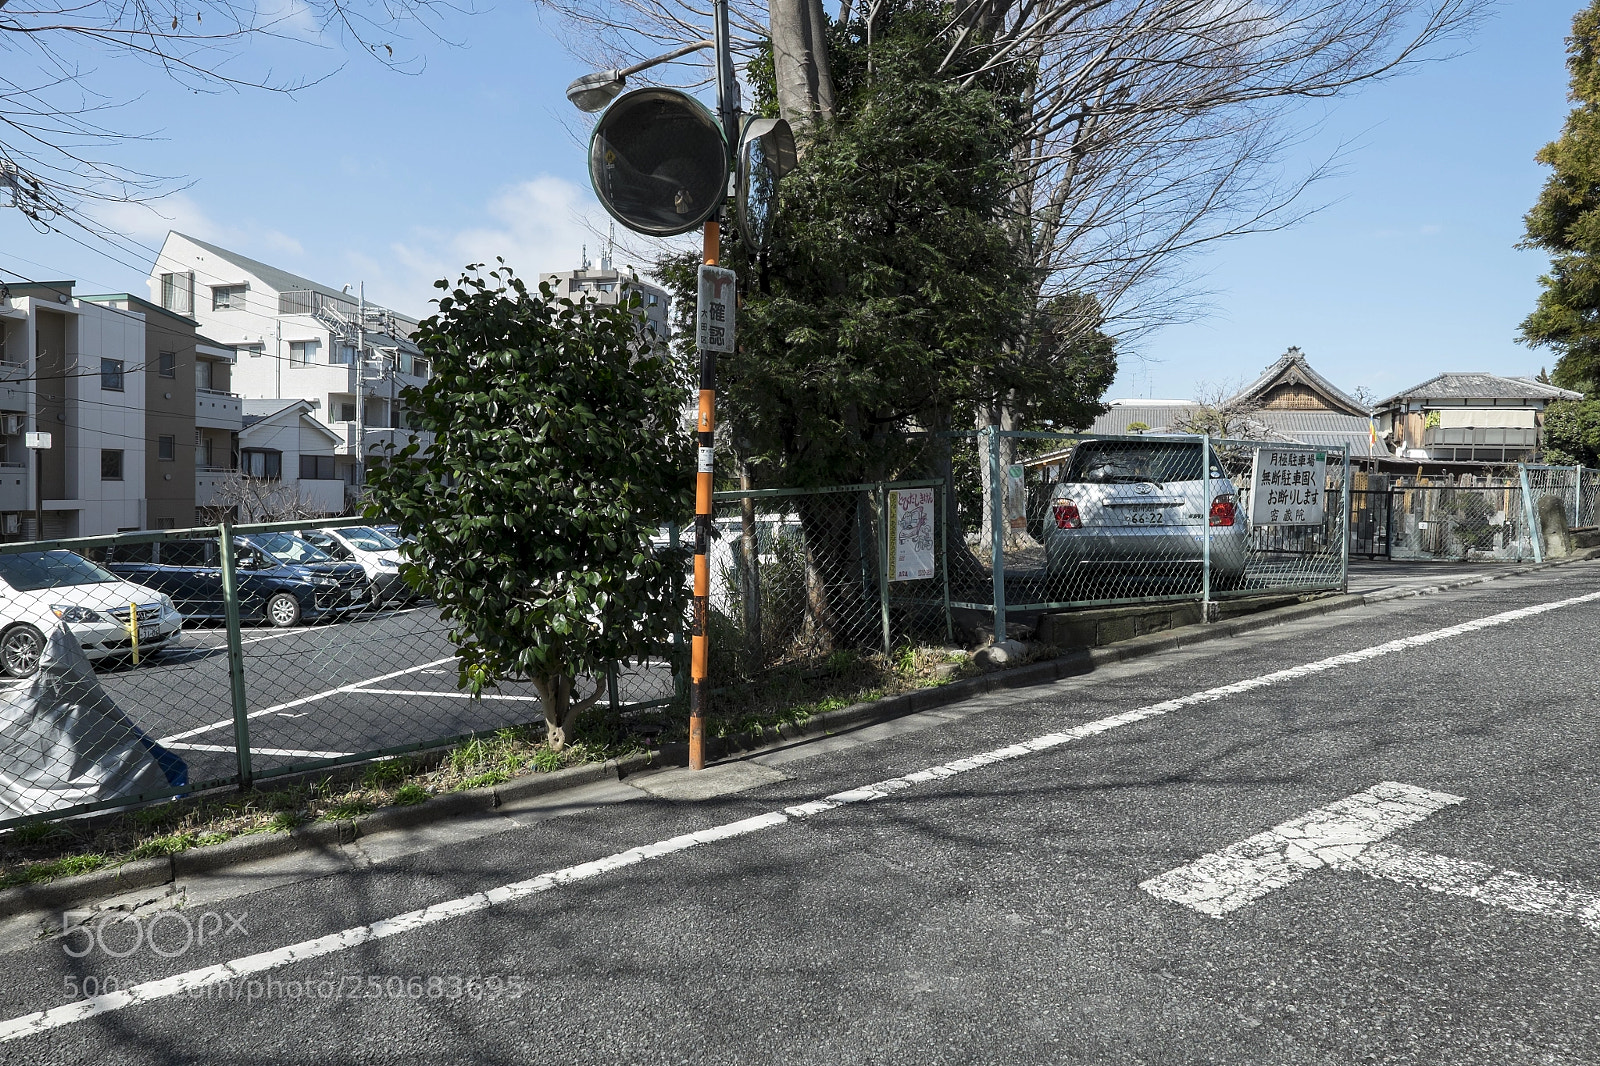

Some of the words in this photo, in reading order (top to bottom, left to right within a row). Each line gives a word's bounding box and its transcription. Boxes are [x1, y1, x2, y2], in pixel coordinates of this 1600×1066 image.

[700, 309, 708, 345] 大田区
[709, 301, 726, 346] 確認
[1269, 452, 1315, 467] 月極駐車場
[1261, 469, 1316, 486] 無断駐車固く
[1267, 489, 1319, 506] お断りします
[1132, 512, 1163, 523] 66-22
